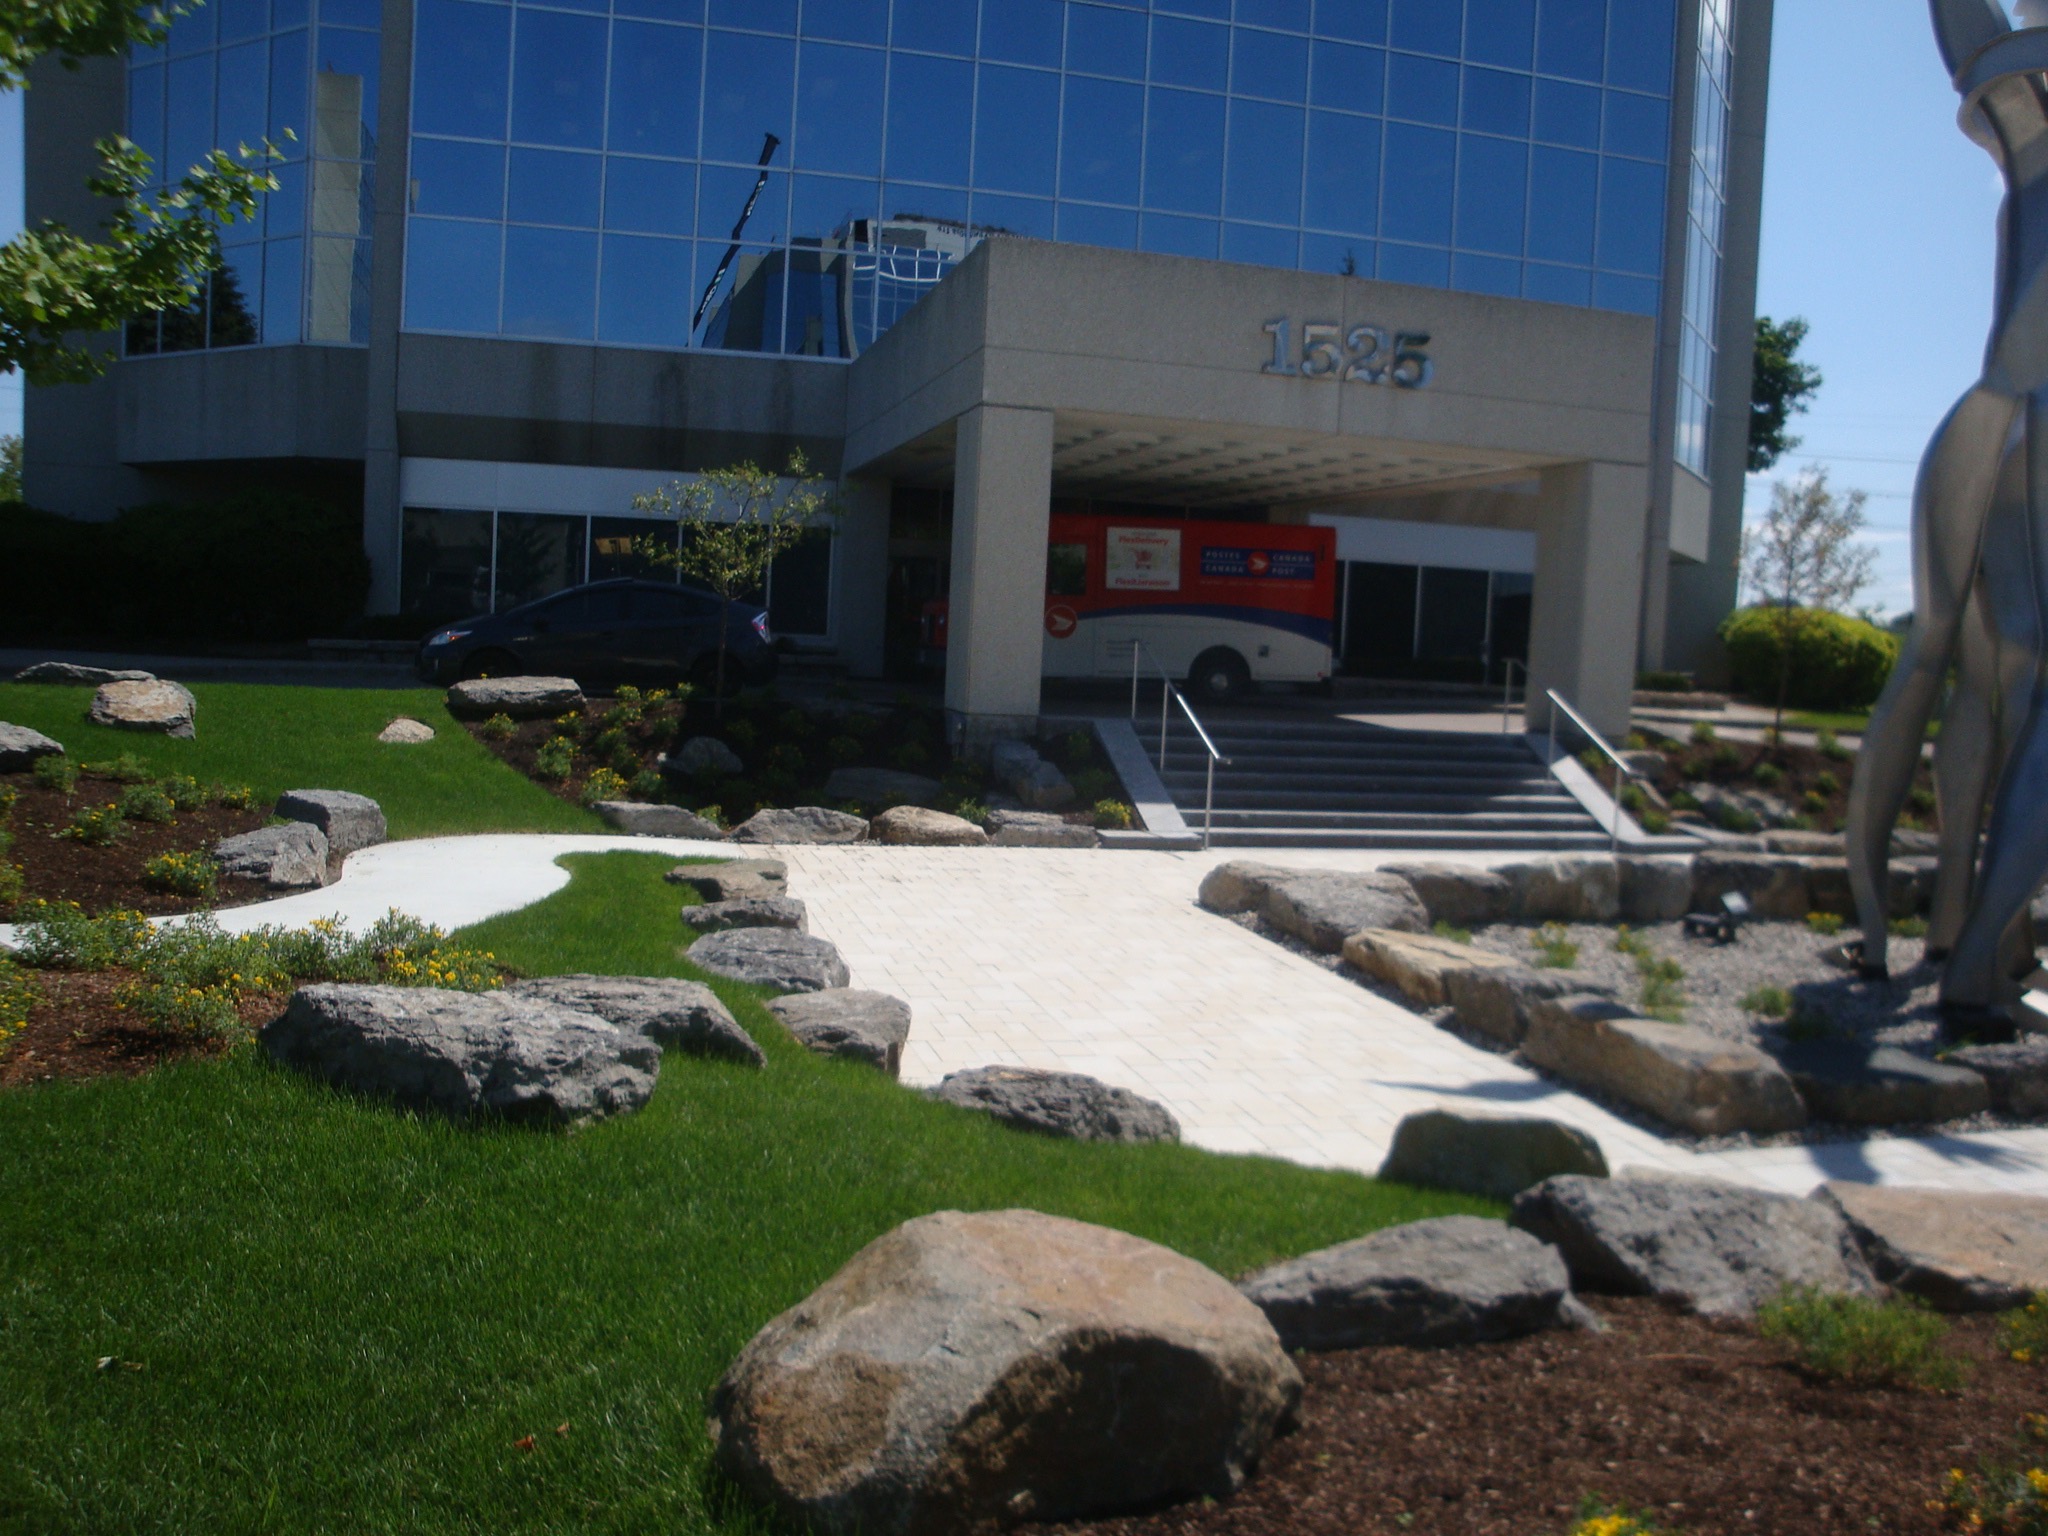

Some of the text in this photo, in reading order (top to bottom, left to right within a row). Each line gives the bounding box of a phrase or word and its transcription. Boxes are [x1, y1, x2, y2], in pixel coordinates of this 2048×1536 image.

[1262, 317, 1434, 388] 1525
[1206, 551, 1240, 559] POSTES
[1272, 554, 1310, 562] CANADA
[1205, 565, 1243, 573] CANADA
[1272, 567, 1296, 575] POST
